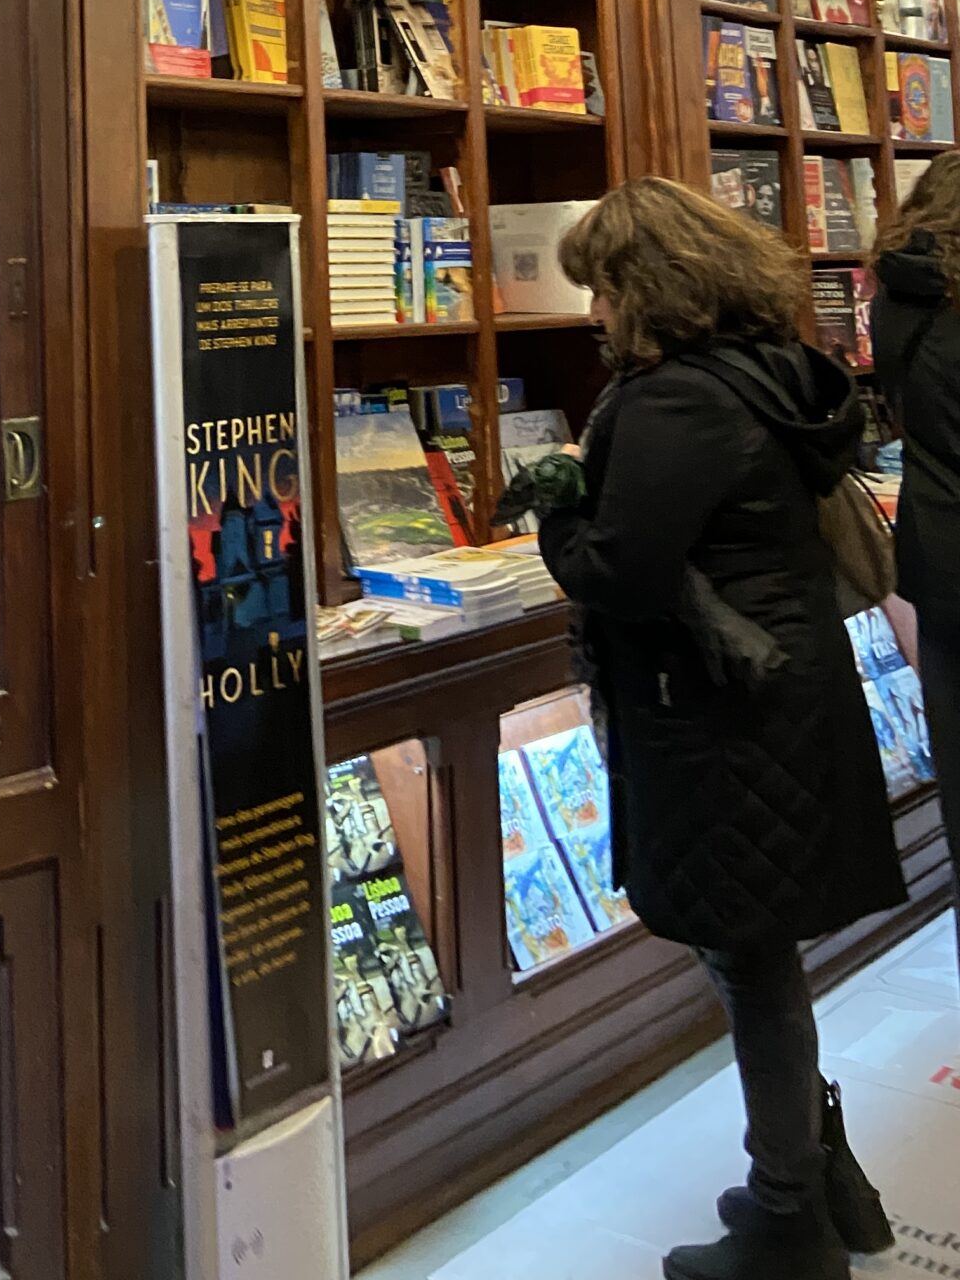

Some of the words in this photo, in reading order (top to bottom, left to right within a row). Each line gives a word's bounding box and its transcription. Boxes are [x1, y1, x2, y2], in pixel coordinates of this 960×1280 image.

[187, 412, 295, 455] STEPHEN
[190, 448, 299, 518] KING
[200, 649, 303, 711] HOLLY
[368, 894, 411, 921] Pessoa
[331, 921, 363, 945] ssoa
